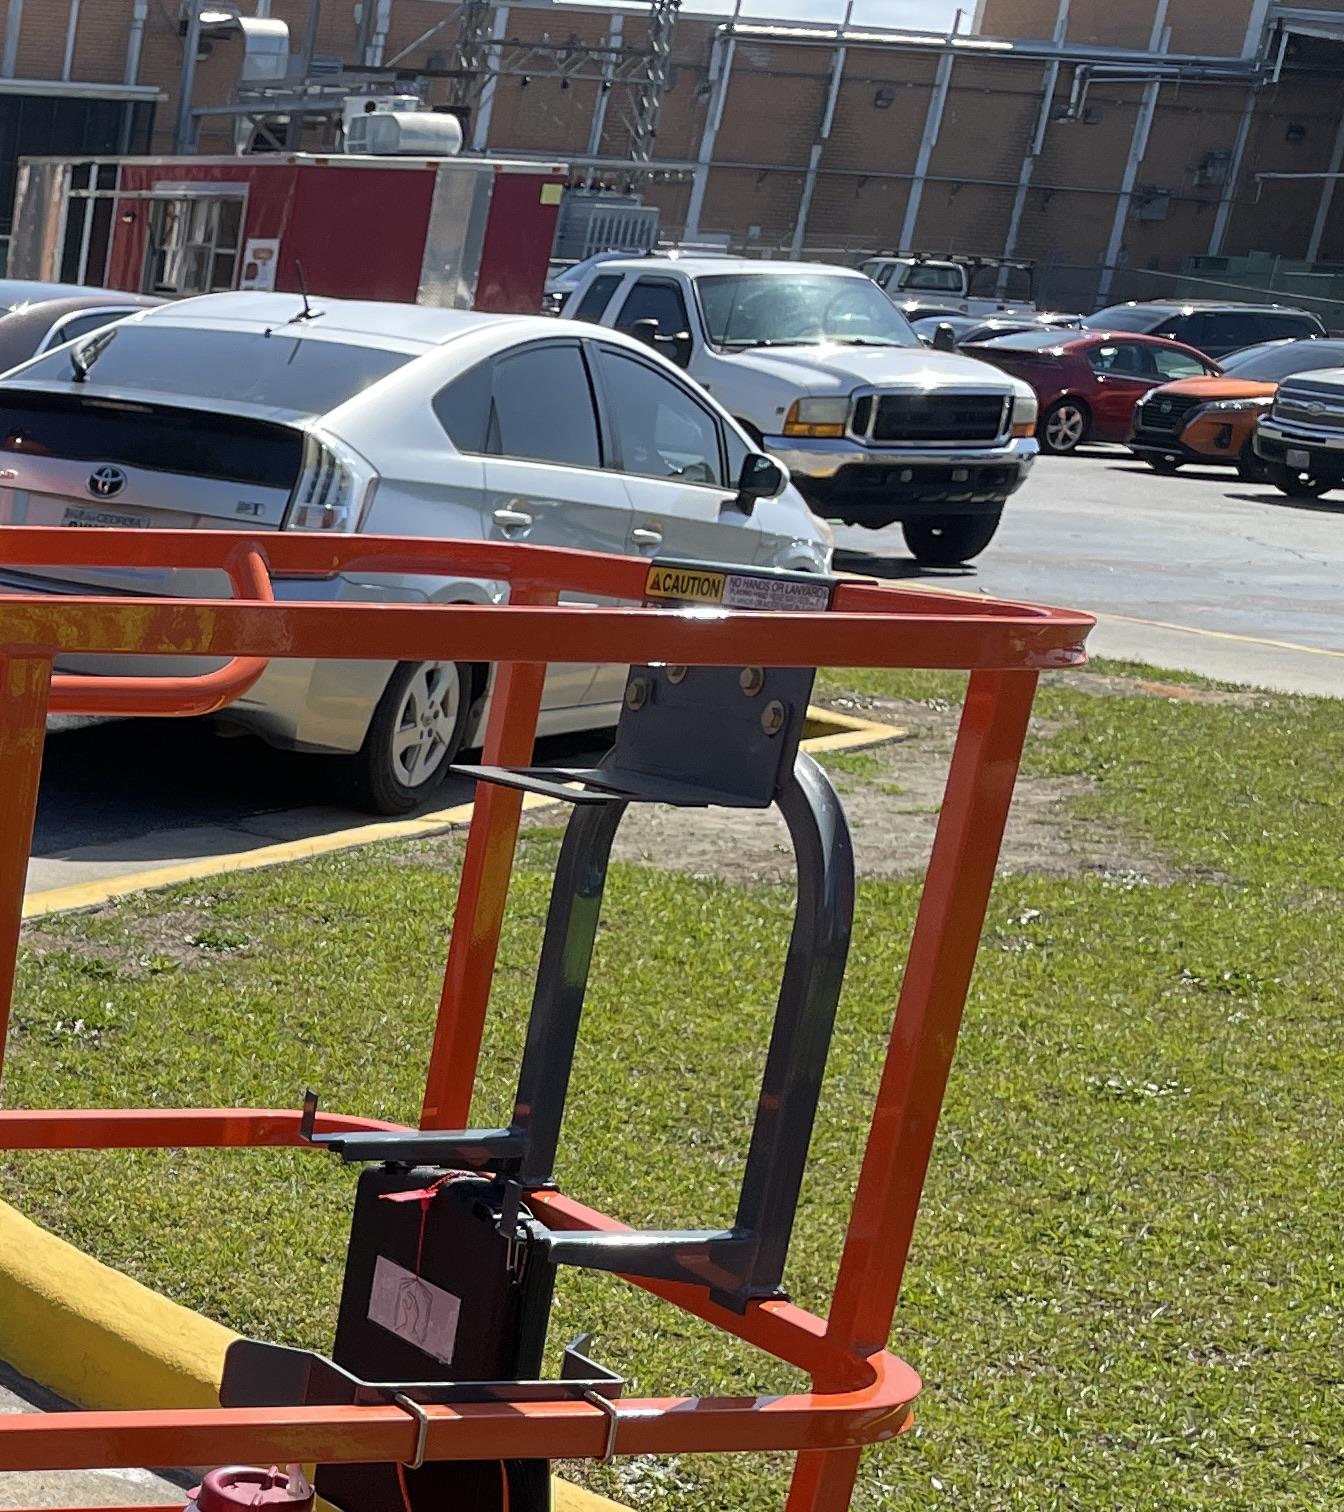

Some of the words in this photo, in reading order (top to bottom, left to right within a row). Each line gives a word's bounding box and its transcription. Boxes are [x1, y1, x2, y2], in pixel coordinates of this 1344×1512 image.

[662, 574, 721, 597] CAUTION
[730, 577, 741, 588] NO
[742, 578, 770, 591] HANDS
[771, 581, 784, 593] OR
